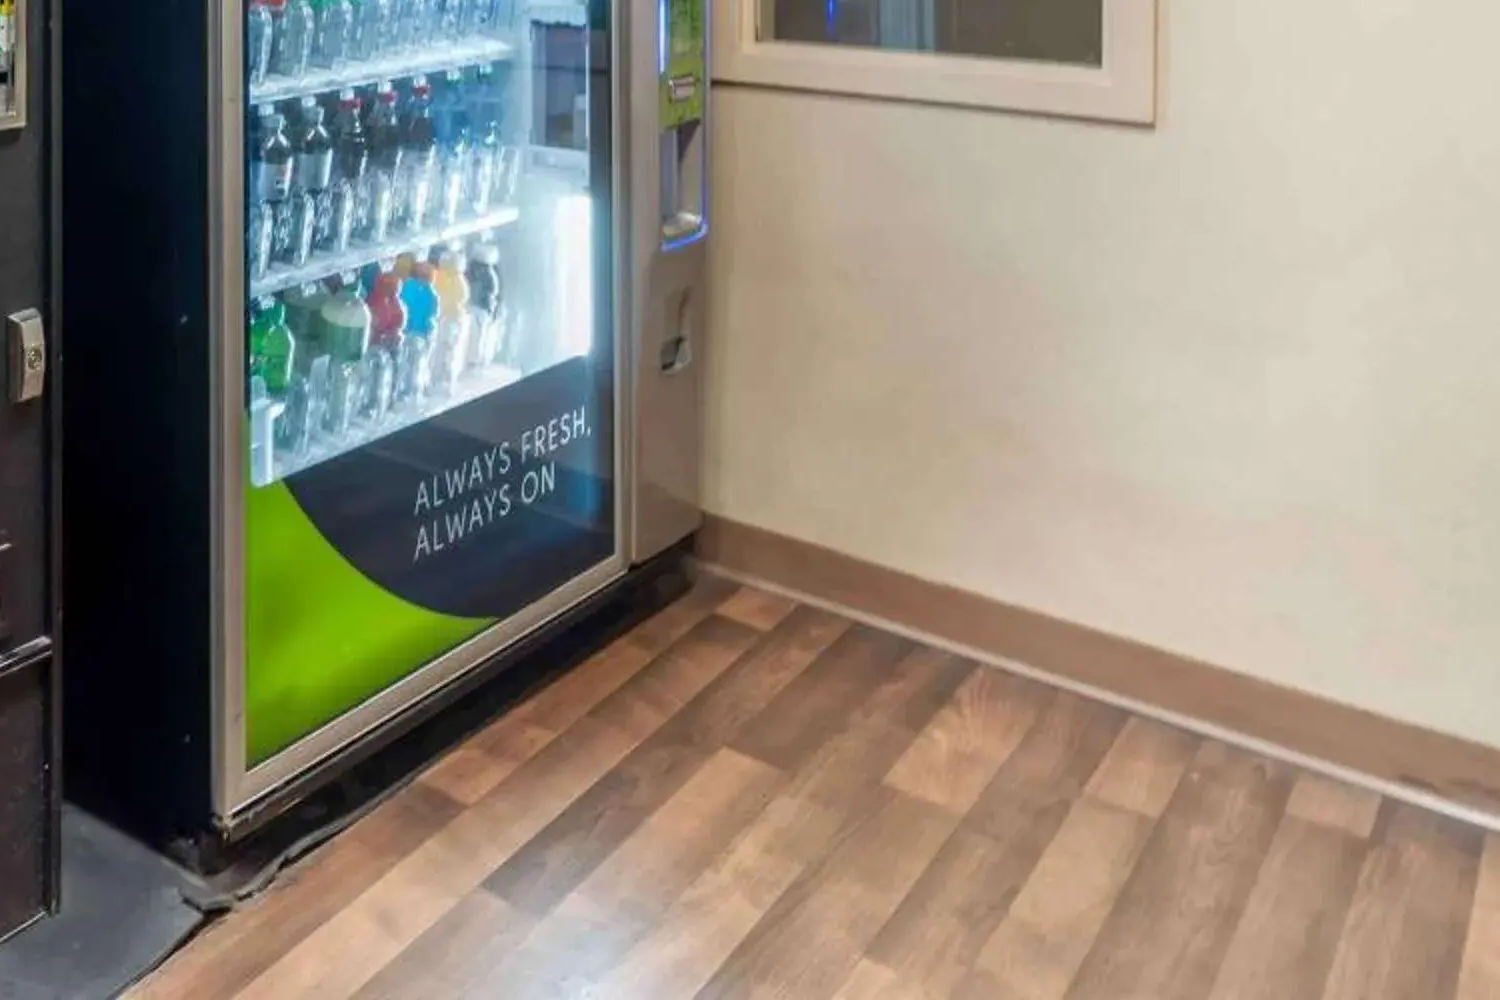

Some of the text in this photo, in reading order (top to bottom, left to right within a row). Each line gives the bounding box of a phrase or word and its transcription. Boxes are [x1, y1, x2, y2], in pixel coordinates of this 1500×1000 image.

[414, 406, 592, 516] ALWAYS FRESH.
[414, 461, 556, 562] ALWAYS ON
